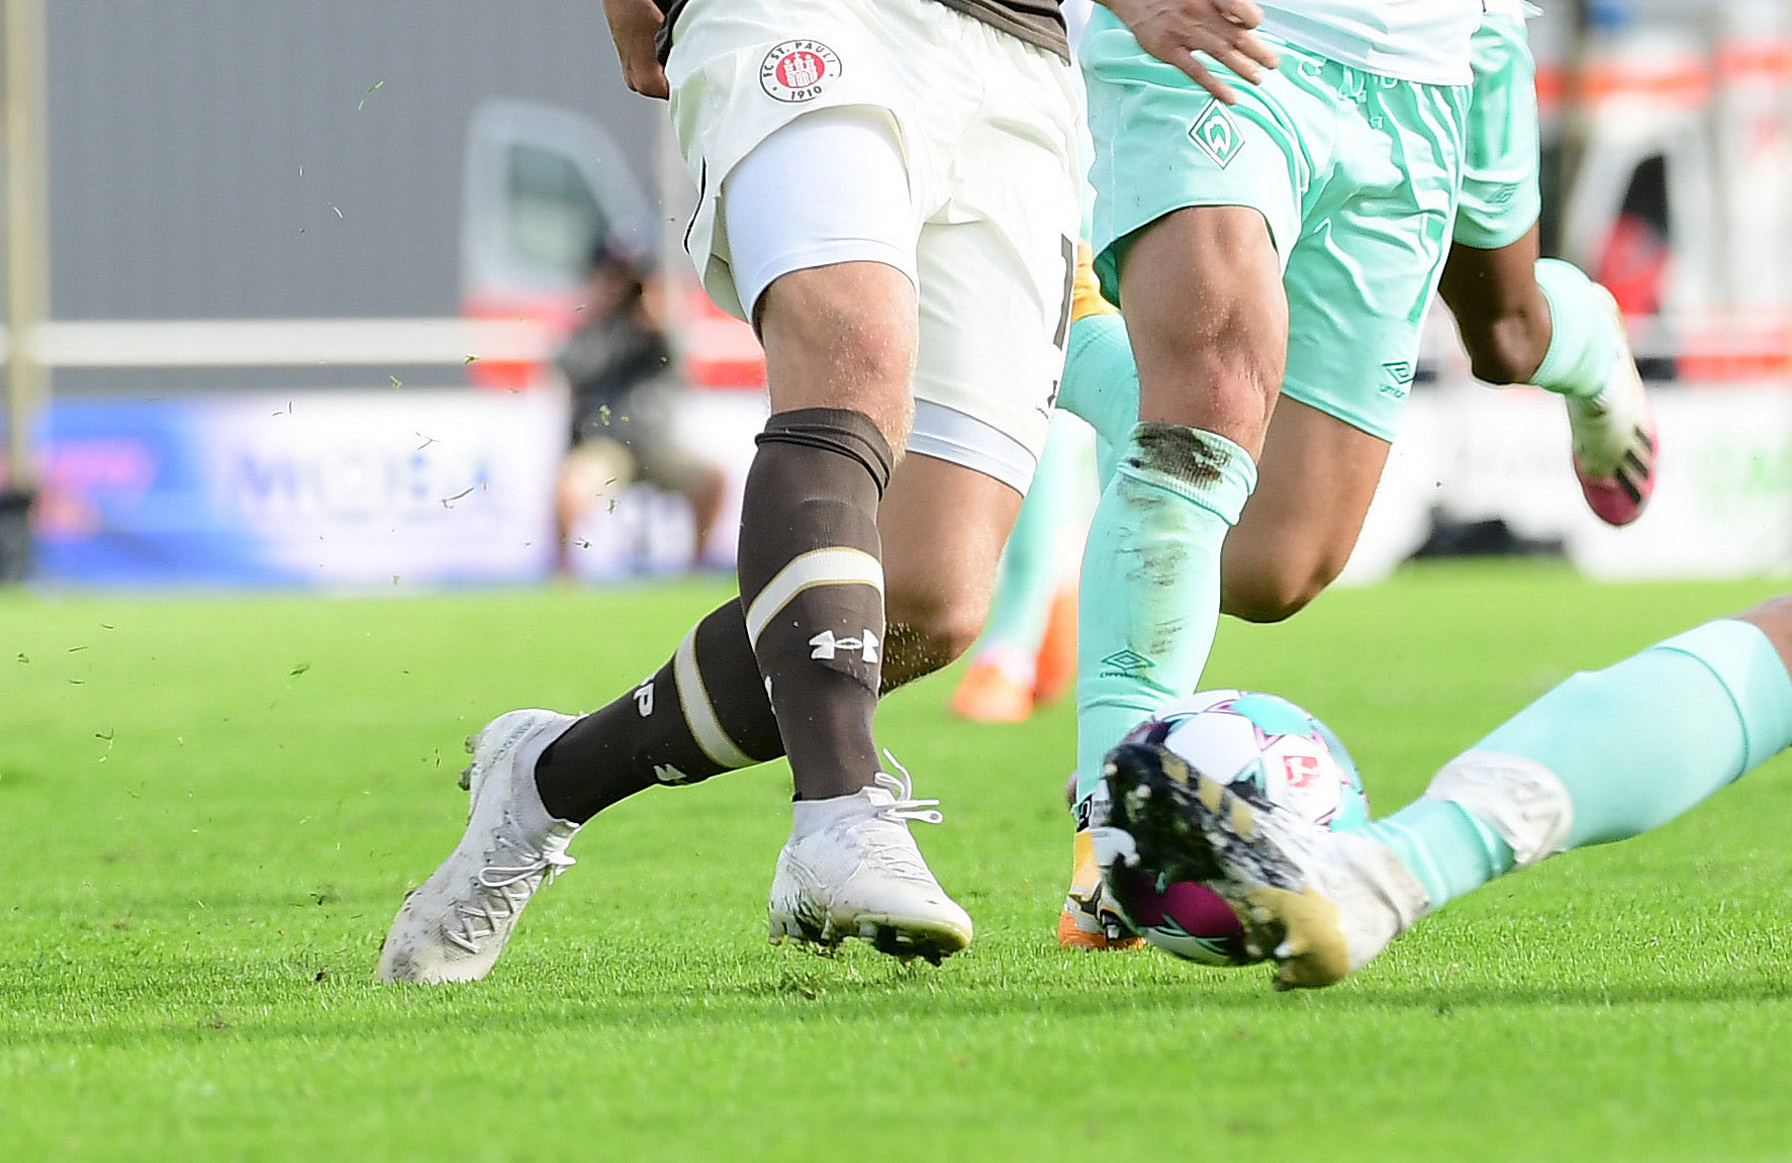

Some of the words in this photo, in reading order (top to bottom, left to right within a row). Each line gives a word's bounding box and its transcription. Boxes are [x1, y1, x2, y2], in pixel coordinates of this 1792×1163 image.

[762, 64, 775, 78] FC
[770, 47, 790, 60] ST.
[795, 42, 836, 63] PAULI
[791, 85, 822, 101] 1910
